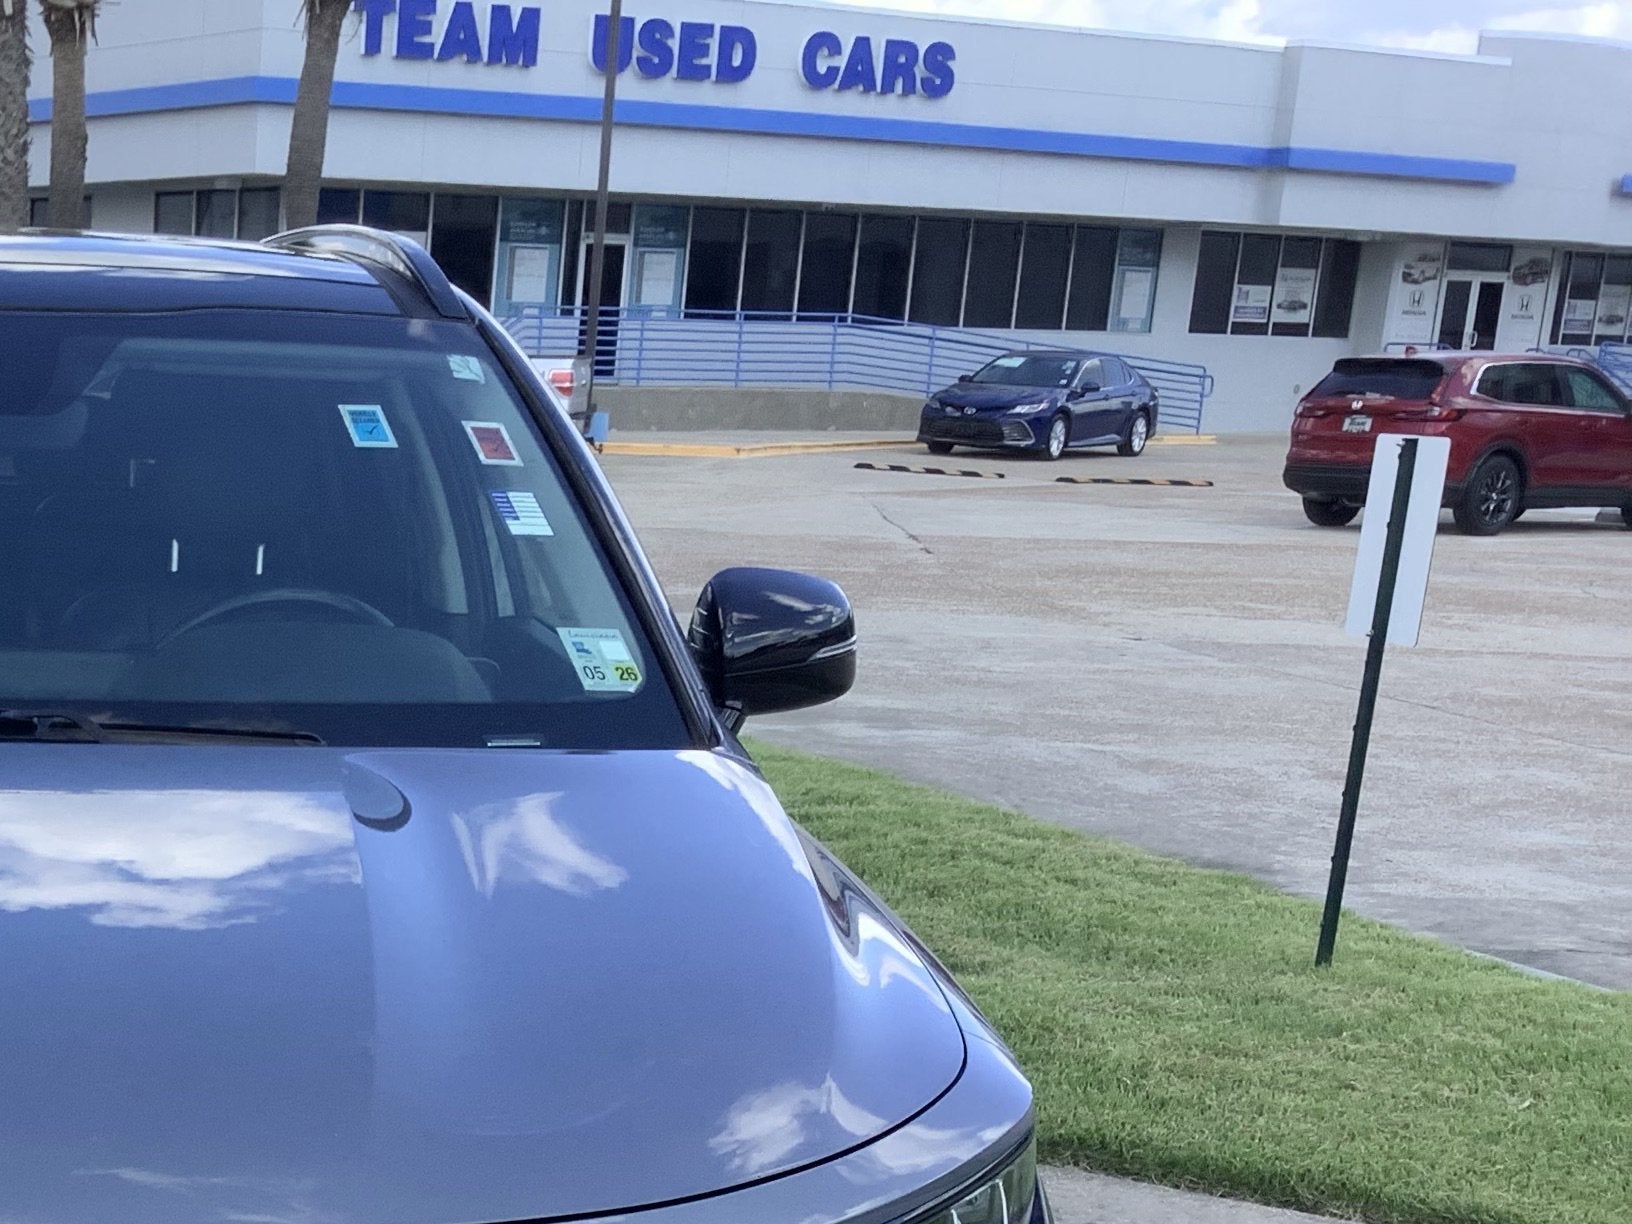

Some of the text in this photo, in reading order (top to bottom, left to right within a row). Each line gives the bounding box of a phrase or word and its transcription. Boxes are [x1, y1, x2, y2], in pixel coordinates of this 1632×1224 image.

[353, 0, 957, 98] TEAM USED CARS
[583, 665, 638, 681] 05 26
